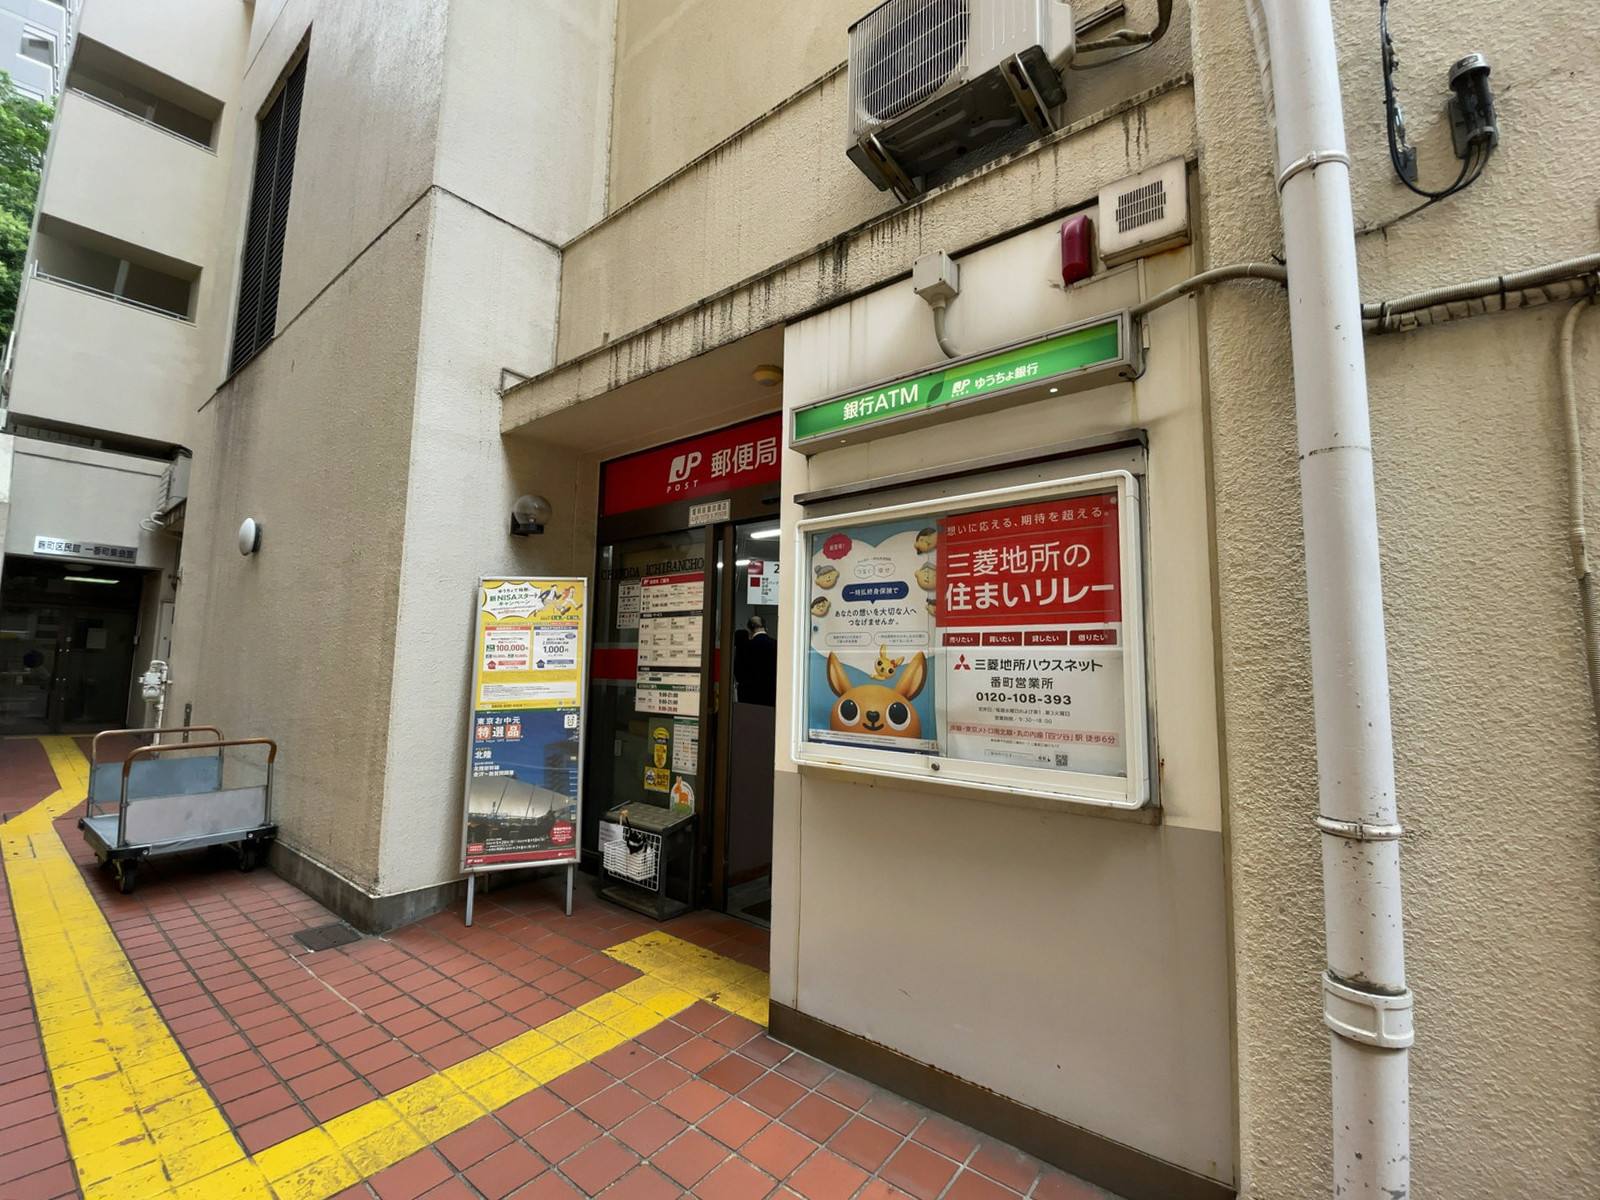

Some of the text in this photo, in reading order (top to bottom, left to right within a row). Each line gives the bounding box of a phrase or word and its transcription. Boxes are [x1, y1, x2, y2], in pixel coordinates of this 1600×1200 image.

[974, 362, 1039, 391] ゆうちょ銀行
[842, 384, 919, 420] 銀行ATM
[710, 437, 778, 479] 郵便局
[666, 480, 699, 493] POST
[947, 506, 1110, 536] 想いに応える、期待を超える。
[946, 541, 1091, 578] 三菱地所の
[489, 592, 538, 602] 新NISAスタート
[849, 588, 899, 597] 一時払終身保険で
[945, 577, 1114, 612] 住まいリレー
[834, 606, 917, 618] あなたの想いを大切な人へ
[848, 618, 900, 626] つなげませんか。
[989, 634, 1015, 643] 買いたい
[1032, 634, 1059, 643] 貸したい
[974, 658, 1103, 672] 三菱地所ハウスネット
[990, 676, 1054, 690] 番町営業所
[976, 692, 1072, 705] 0120-108-393
[476, 716, 521, 725] 東京お中元
[476, 725, 521, 738] 特選品
[1085, 733, 1116, 745] 徒歩6分
[475, 750, 492, 759] 北陸
